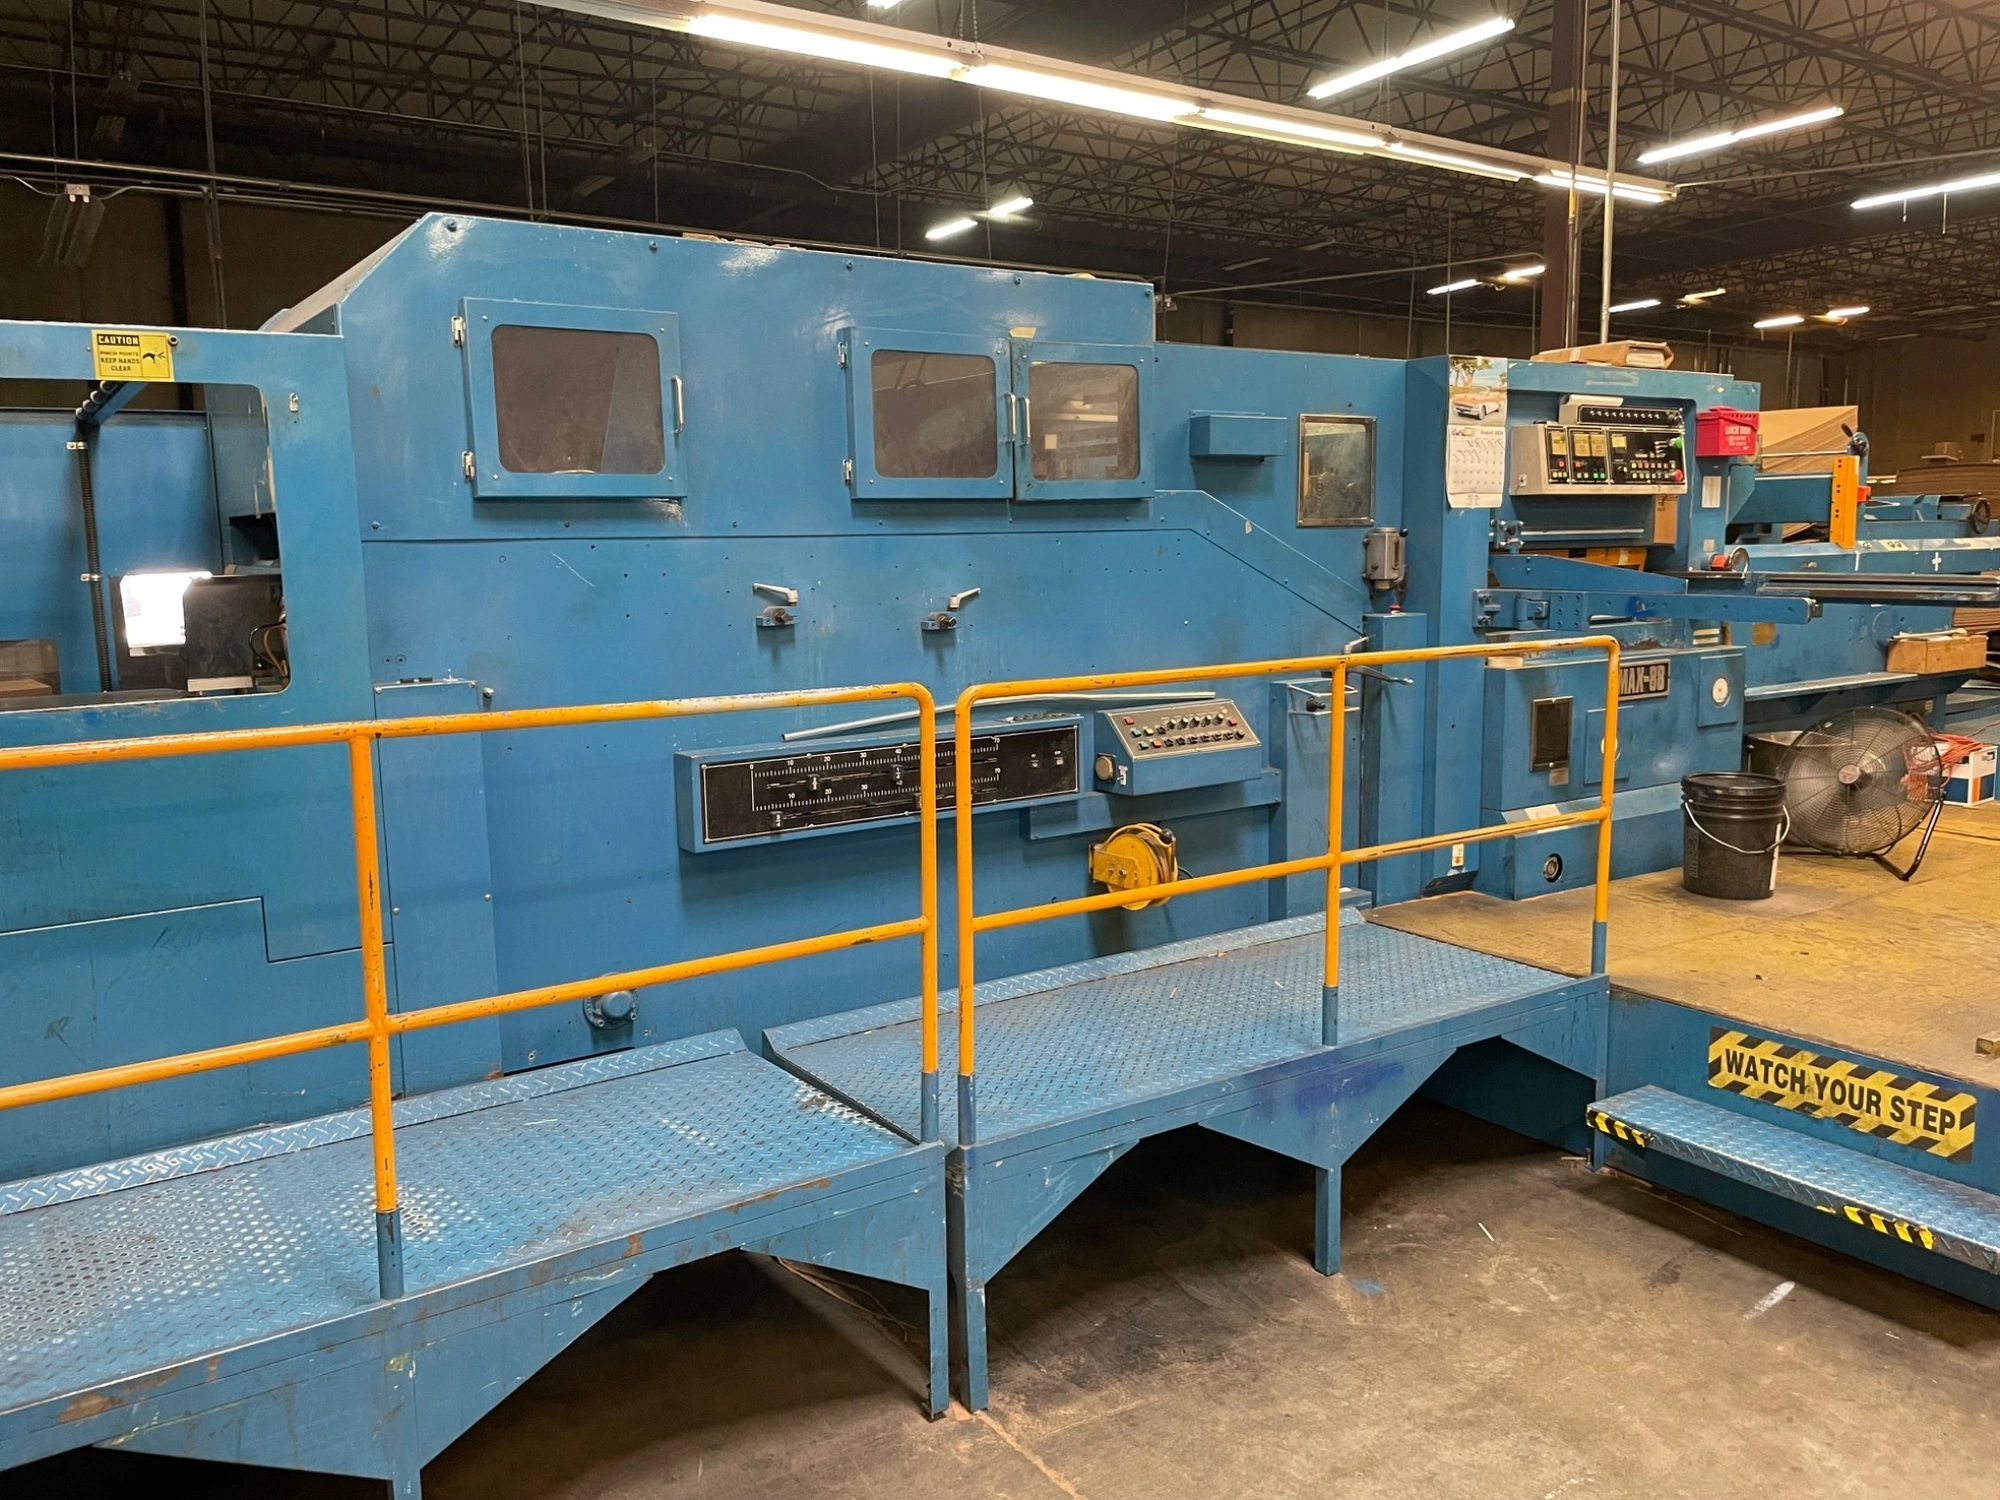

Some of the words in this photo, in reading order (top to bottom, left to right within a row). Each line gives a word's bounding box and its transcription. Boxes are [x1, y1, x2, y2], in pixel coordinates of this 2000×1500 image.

[98, 335, 139, 345] CAUTION
[1725, 1048, 1806, 1095] WATCH
[1813, 1073, 1882, 1117] YOUR
[1889, 1095, 1956, 1135] STEP
